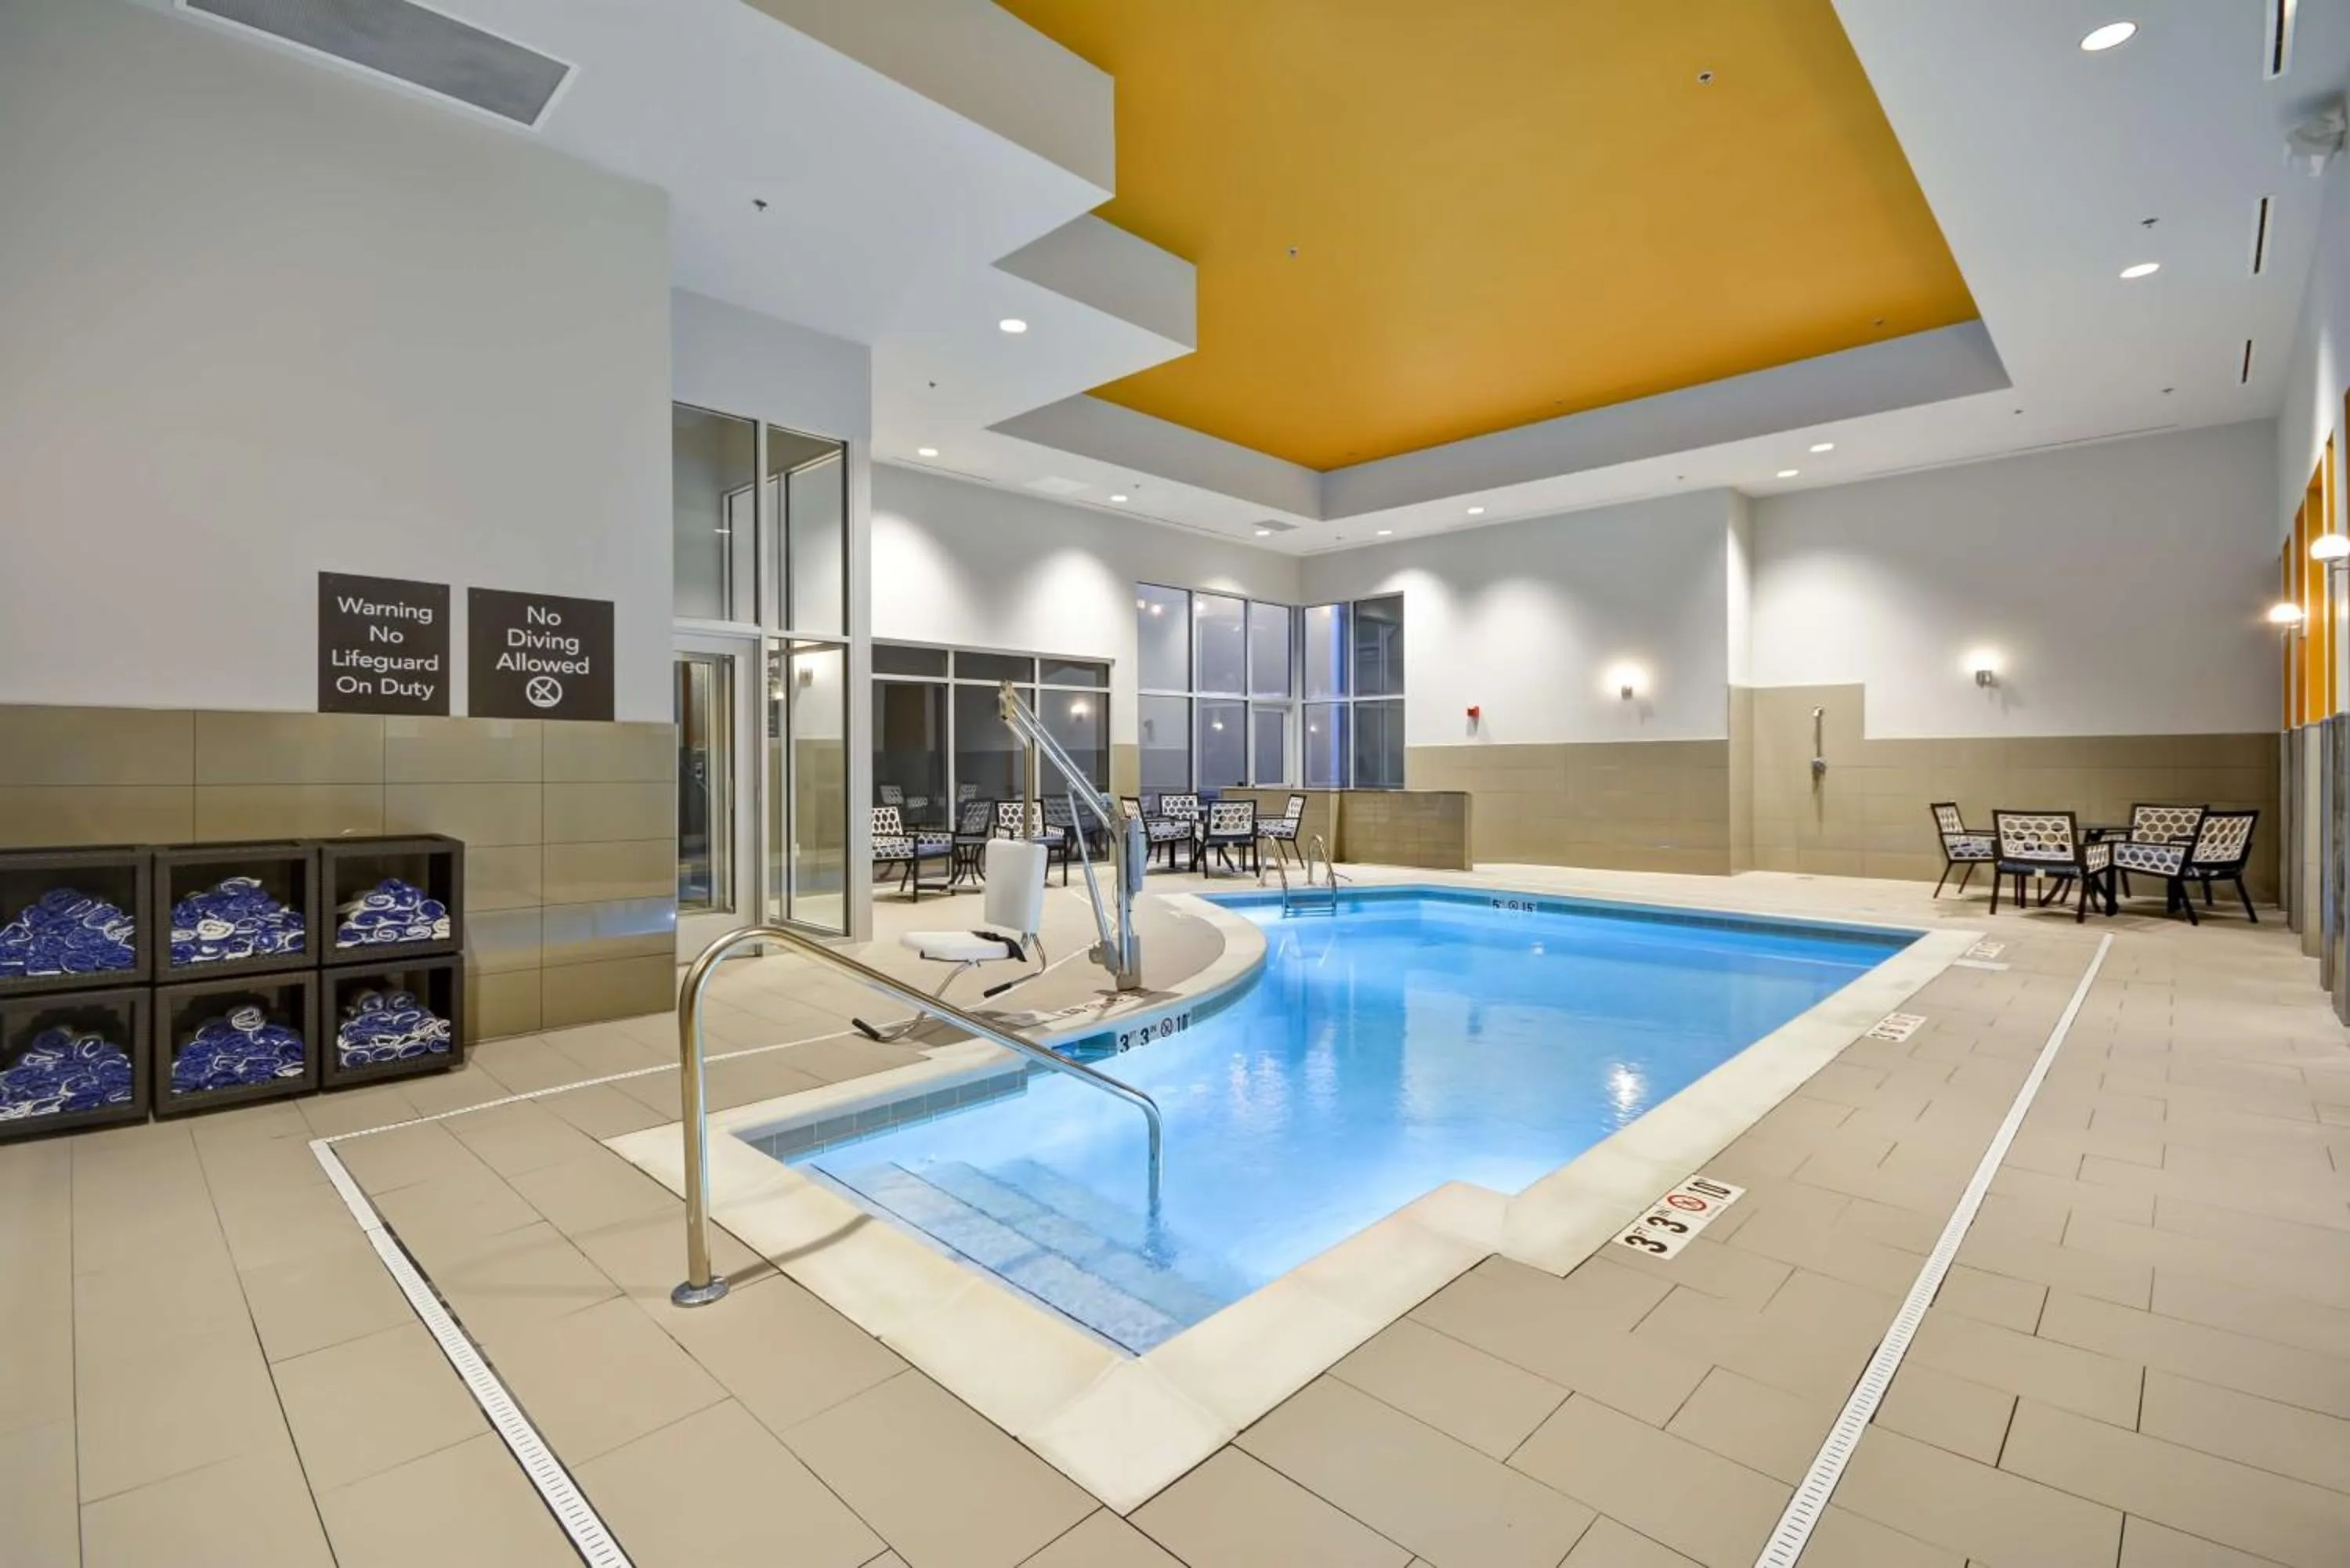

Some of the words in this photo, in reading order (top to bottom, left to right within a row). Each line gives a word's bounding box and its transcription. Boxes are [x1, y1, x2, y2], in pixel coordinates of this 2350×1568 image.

[337, 596, 433, 624] Warning
[526, 606, 562, 626] No
[369, 626, 404, 644] No
[507, 629, 580, 655] Diving
[331, 649, 439, 673] Lifeguard
[496, 653, 591, 674] Allowed
[335, 676, 372, 695] On
[380, 678, 435, 701] Duty
[1119, 1034, 1130, 1053] 3
[1140, 1028, 1149, 1046] 3
[1624, 1235, 1668, 1254] 3
[1646, 1216, 1689, 1234] 3
